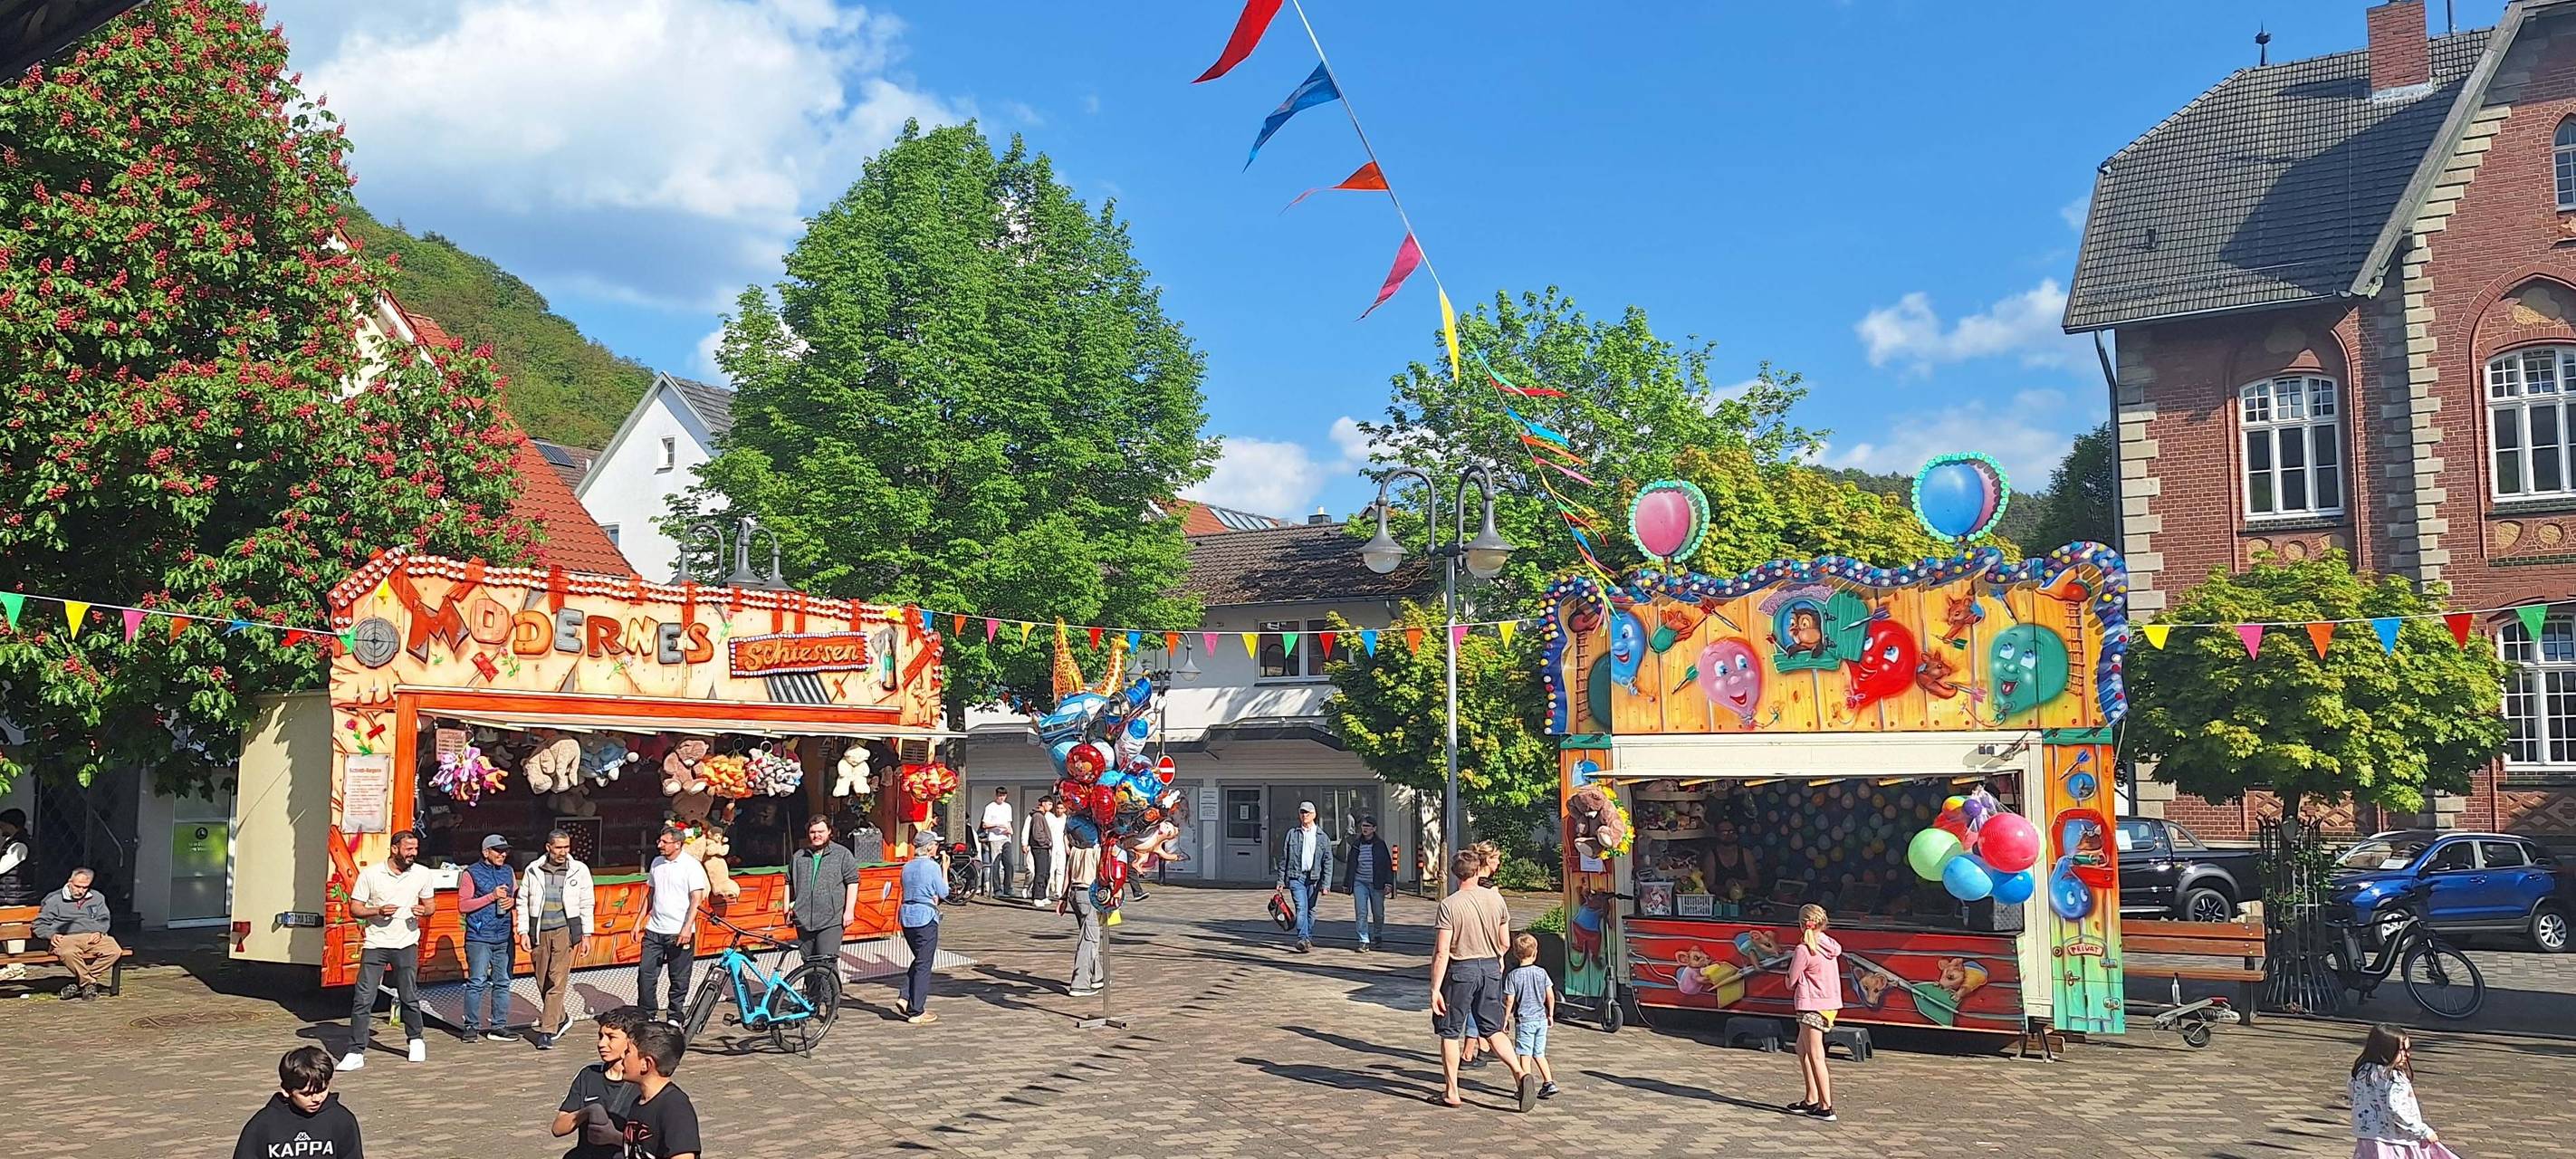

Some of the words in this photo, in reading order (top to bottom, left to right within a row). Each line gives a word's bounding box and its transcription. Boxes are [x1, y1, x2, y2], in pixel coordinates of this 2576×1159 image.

[407, 594, 714, 665] MODERNES
[743, 637, 858, 671] Schiessen
[2070, 945, 2100, 954] PRIVAT
[268, 1140, 334, 1158] KAPPA
